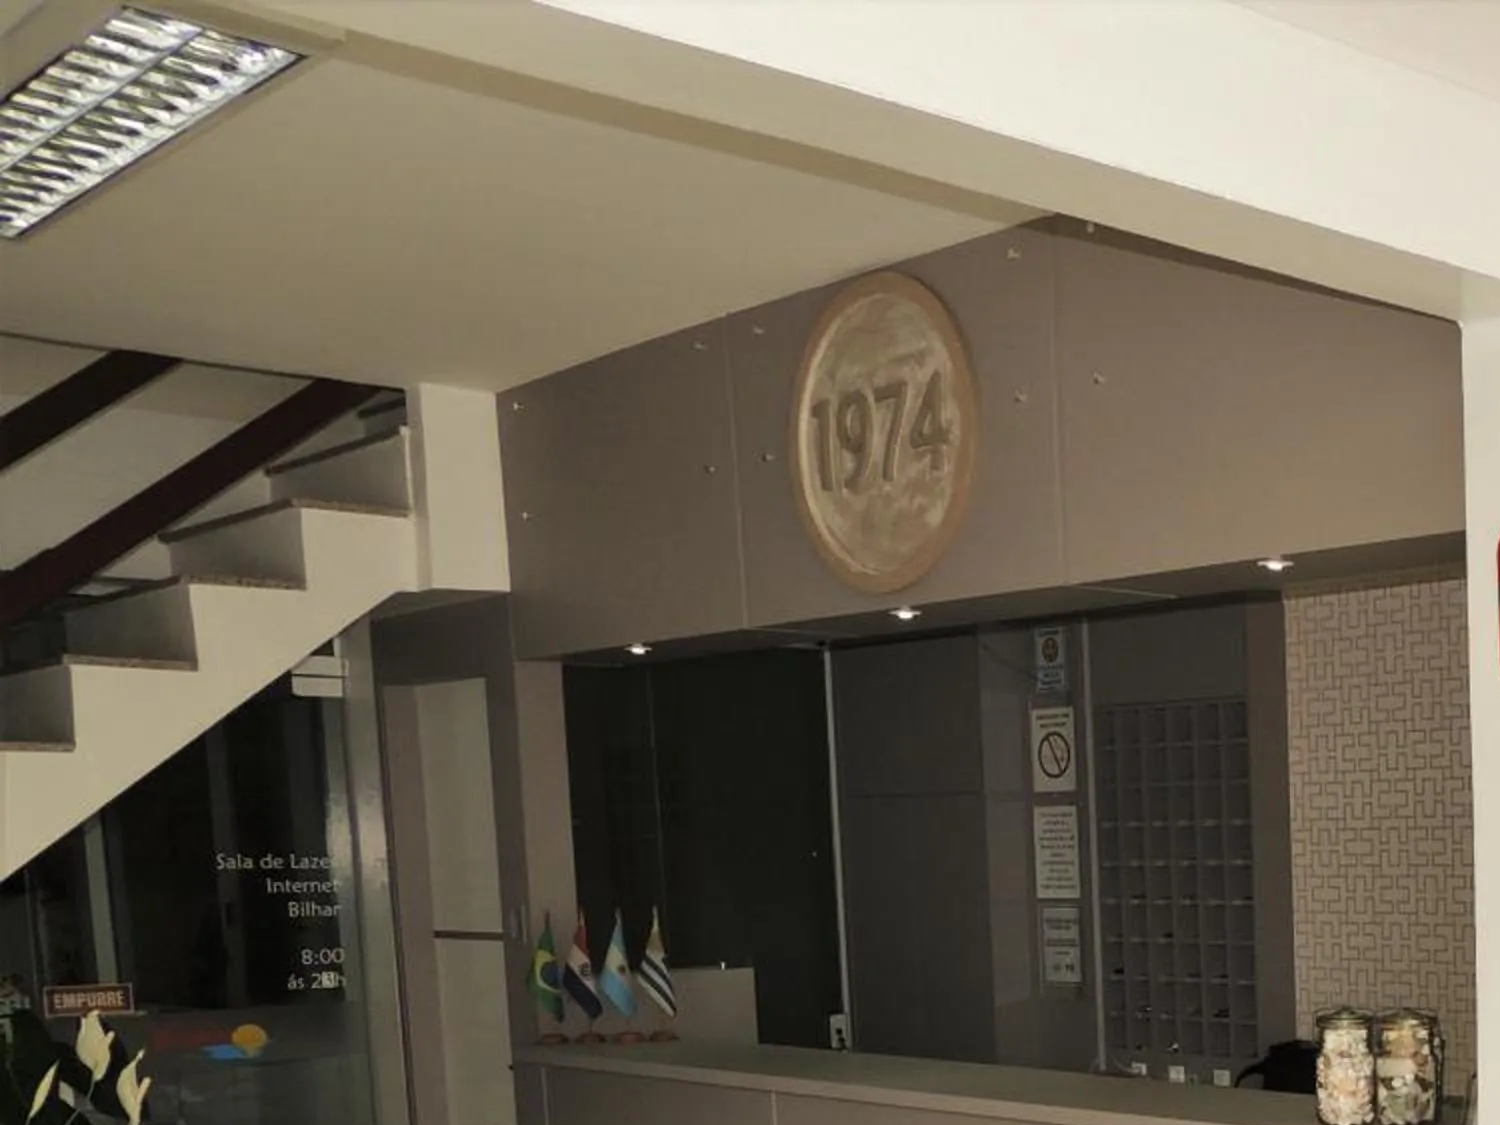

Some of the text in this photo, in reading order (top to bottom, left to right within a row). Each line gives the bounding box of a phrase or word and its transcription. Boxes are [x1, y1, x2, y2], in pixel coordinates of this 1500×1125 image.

[811, 370, 954, 493] 1974
[216, 853, 253, 870] Sala
[260, 853, 284, 869] de
[266, 878, 341, 893] Internet
[287, 901, 342, 917] Bilhar
[301, 947, 344, 965] 8:00
[54, 991, 125, 1009] EMPURRE
